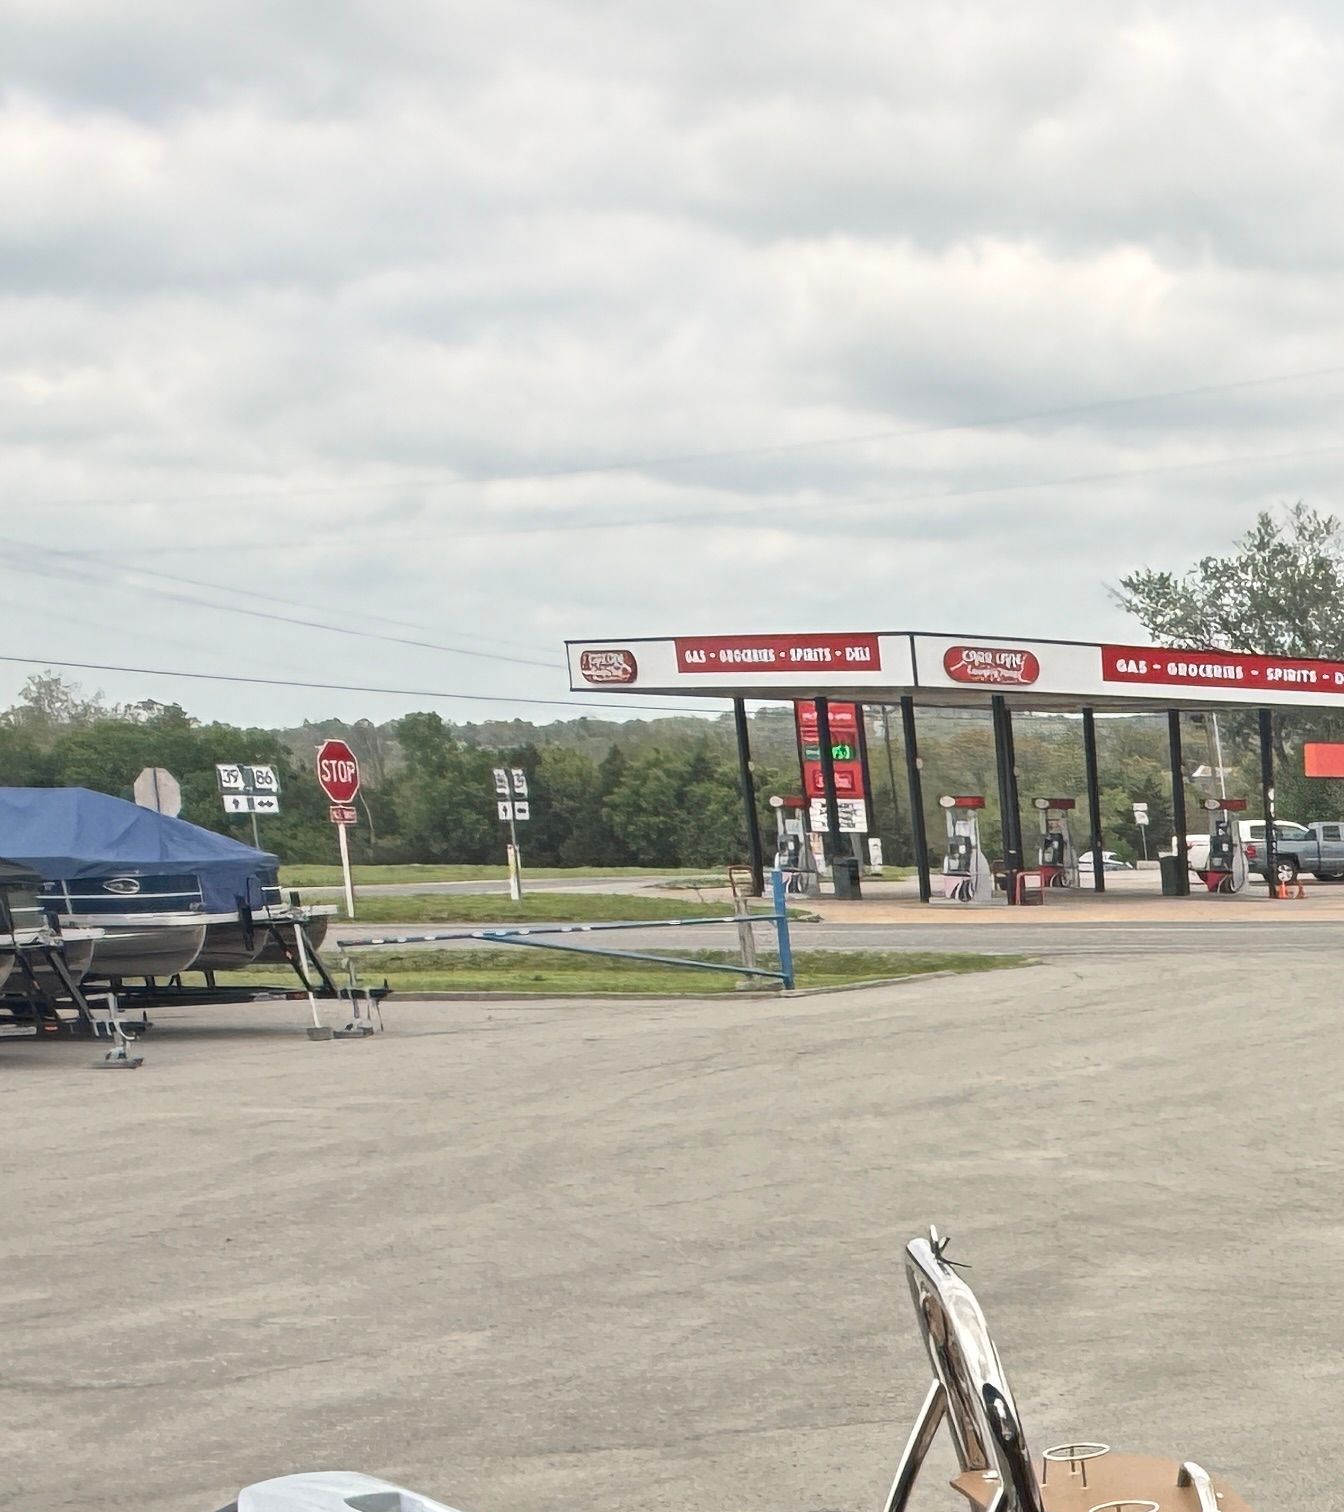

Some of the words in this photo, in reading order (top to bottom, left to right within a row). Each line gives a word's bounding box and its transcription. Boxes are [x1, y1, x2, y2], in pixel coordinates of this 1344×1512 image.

[685, 649, 706, 663] GAS
[789, 647, 832, 662] SPIRITS
[845, 646, 871, 661] DELI
[1115, 658, 1147, 674] GAS
[1167, 662, 1244, 680] GROCERIES
[1266, 667, 1317, 684] SPIRITS
[222, 768, 239, 784] 39
[256, 770, 273, 785] 86
[321, 759, 355, 783] STOP
